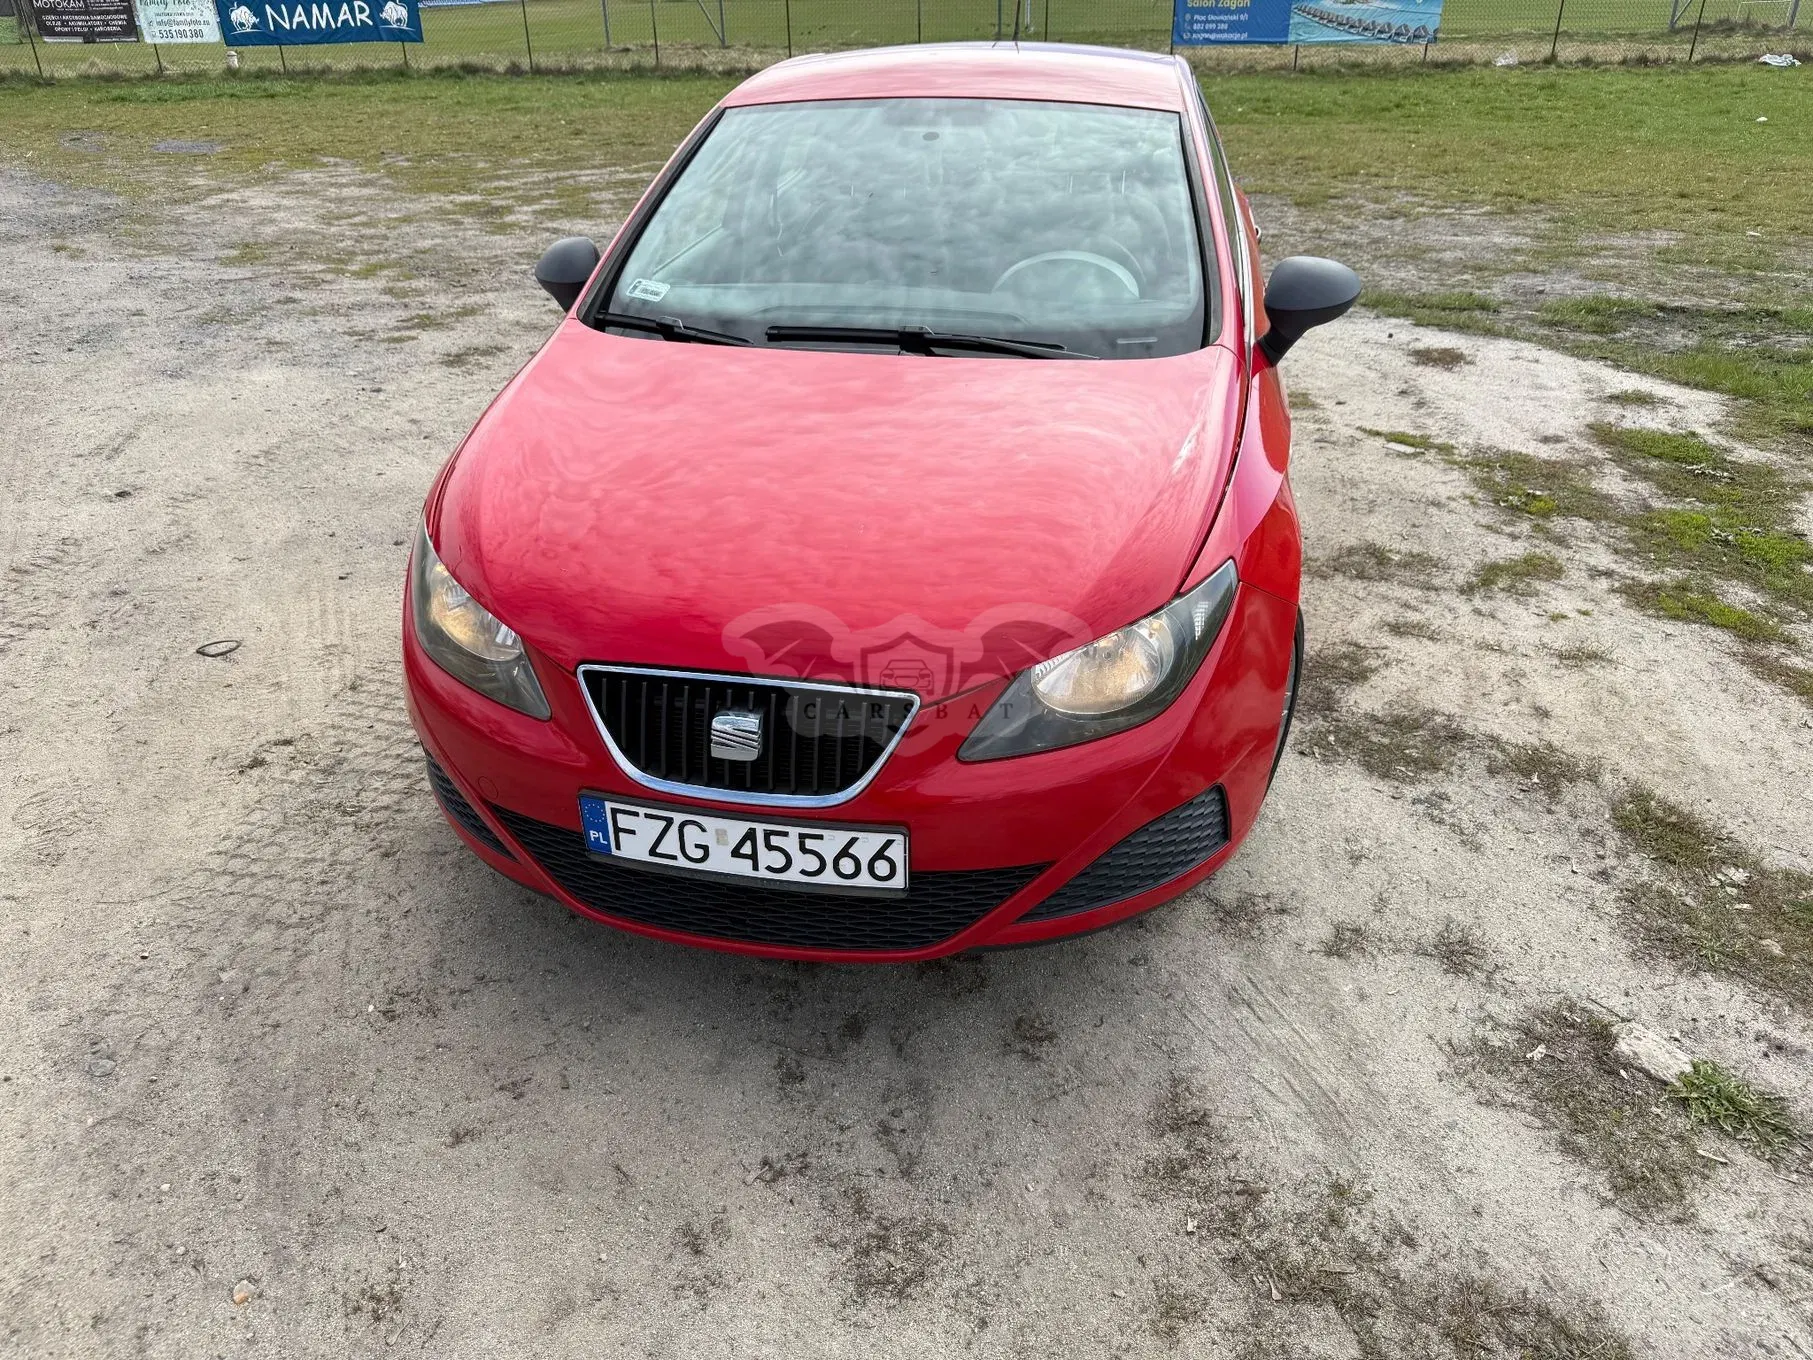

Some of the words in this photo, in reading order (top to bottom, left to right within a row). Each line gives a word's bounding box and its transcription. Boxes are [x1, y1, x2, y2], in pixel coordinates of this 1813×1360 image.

[265, 1, 373, 31] NAMAR
[159, 30, 174, 39] 535
[174, 29, 188, 38] 190
[189, 29, 204, 38] 380
[589, 830, 608, 845] PL
[610, 807, 710, 864] FZG
[730, 827, 897, 882] 45566
